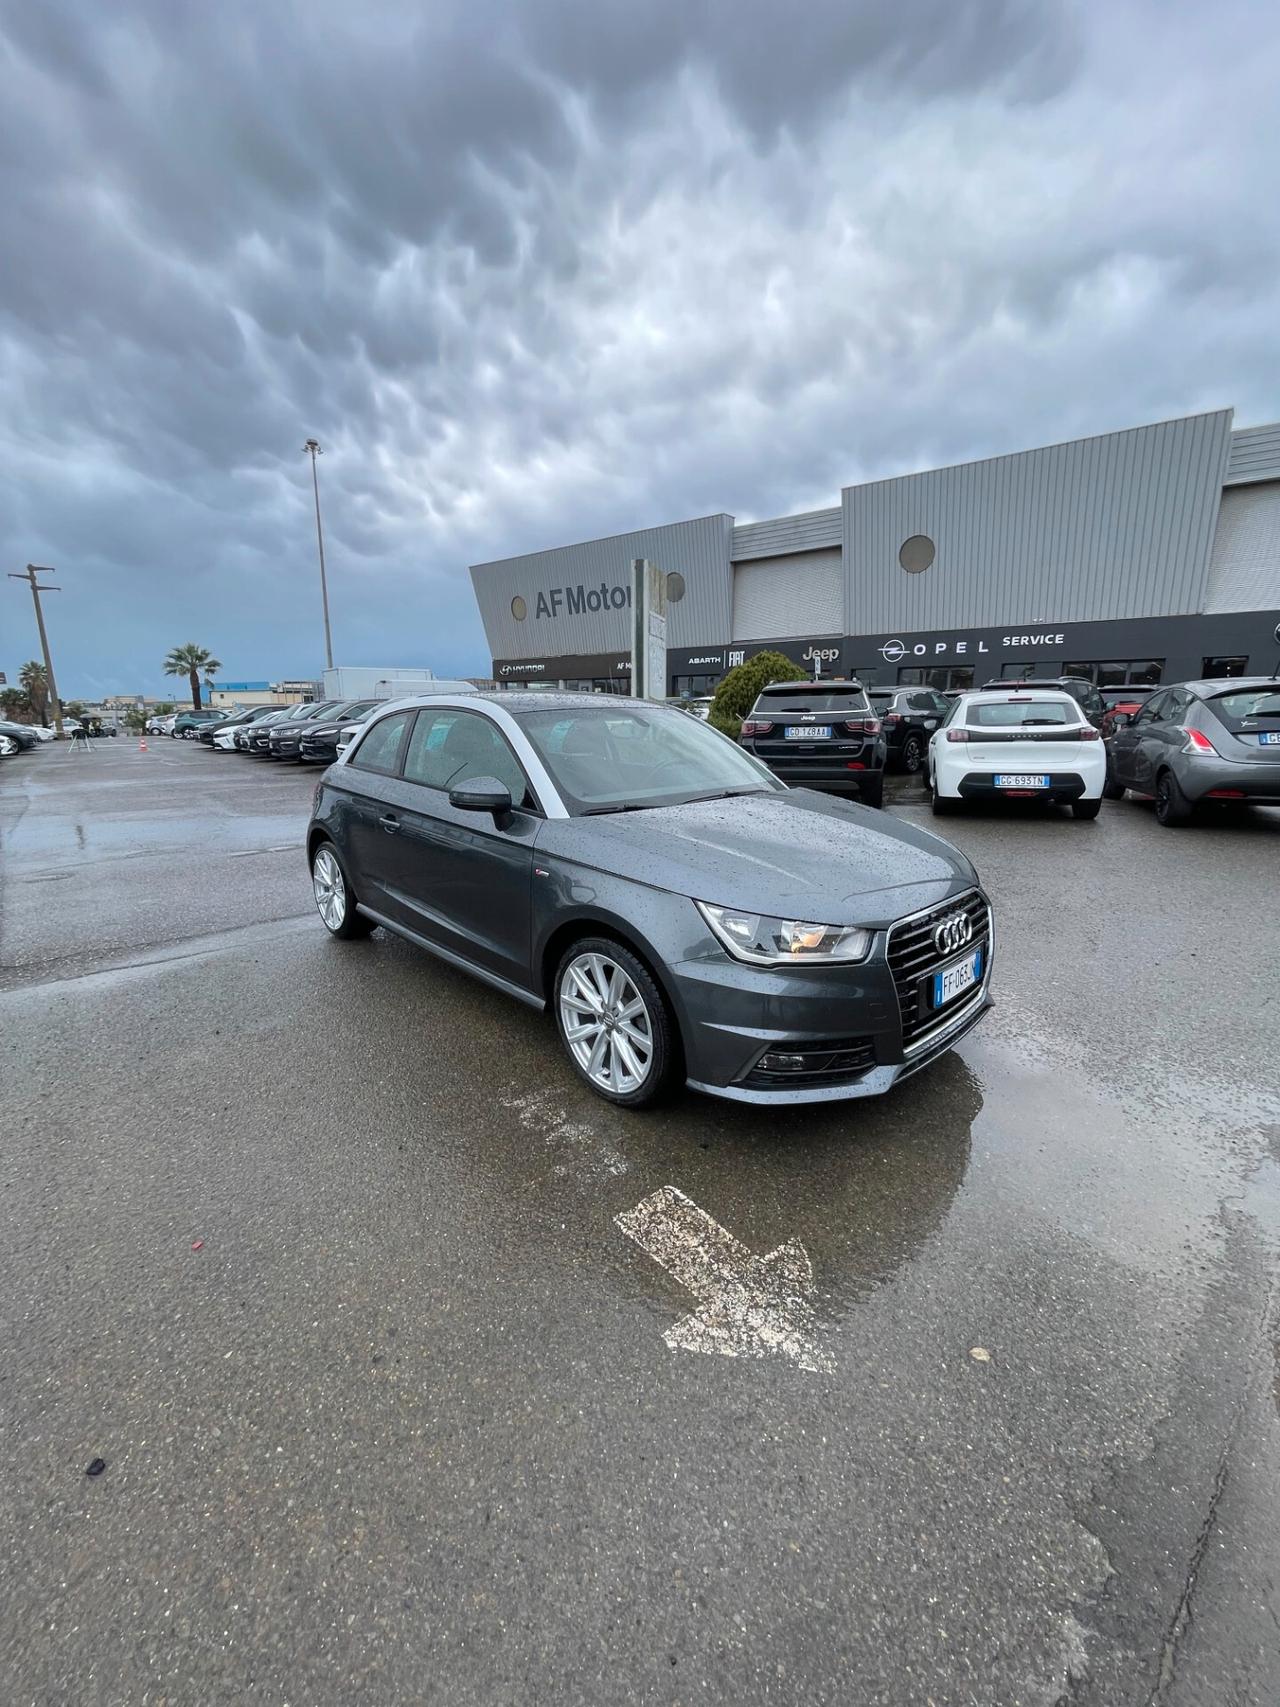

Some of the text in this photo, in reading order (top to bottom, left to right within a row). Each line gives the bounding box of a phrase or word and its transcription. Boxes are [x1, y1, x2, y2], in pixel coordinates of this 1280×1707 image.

[913, 633, 1065, 656] OPEL SERVICE
[688, 656, 721, 665] ABARTH
[728, 650, 746, 667] FIAT
[802, 646, 840, 662] Jeep
